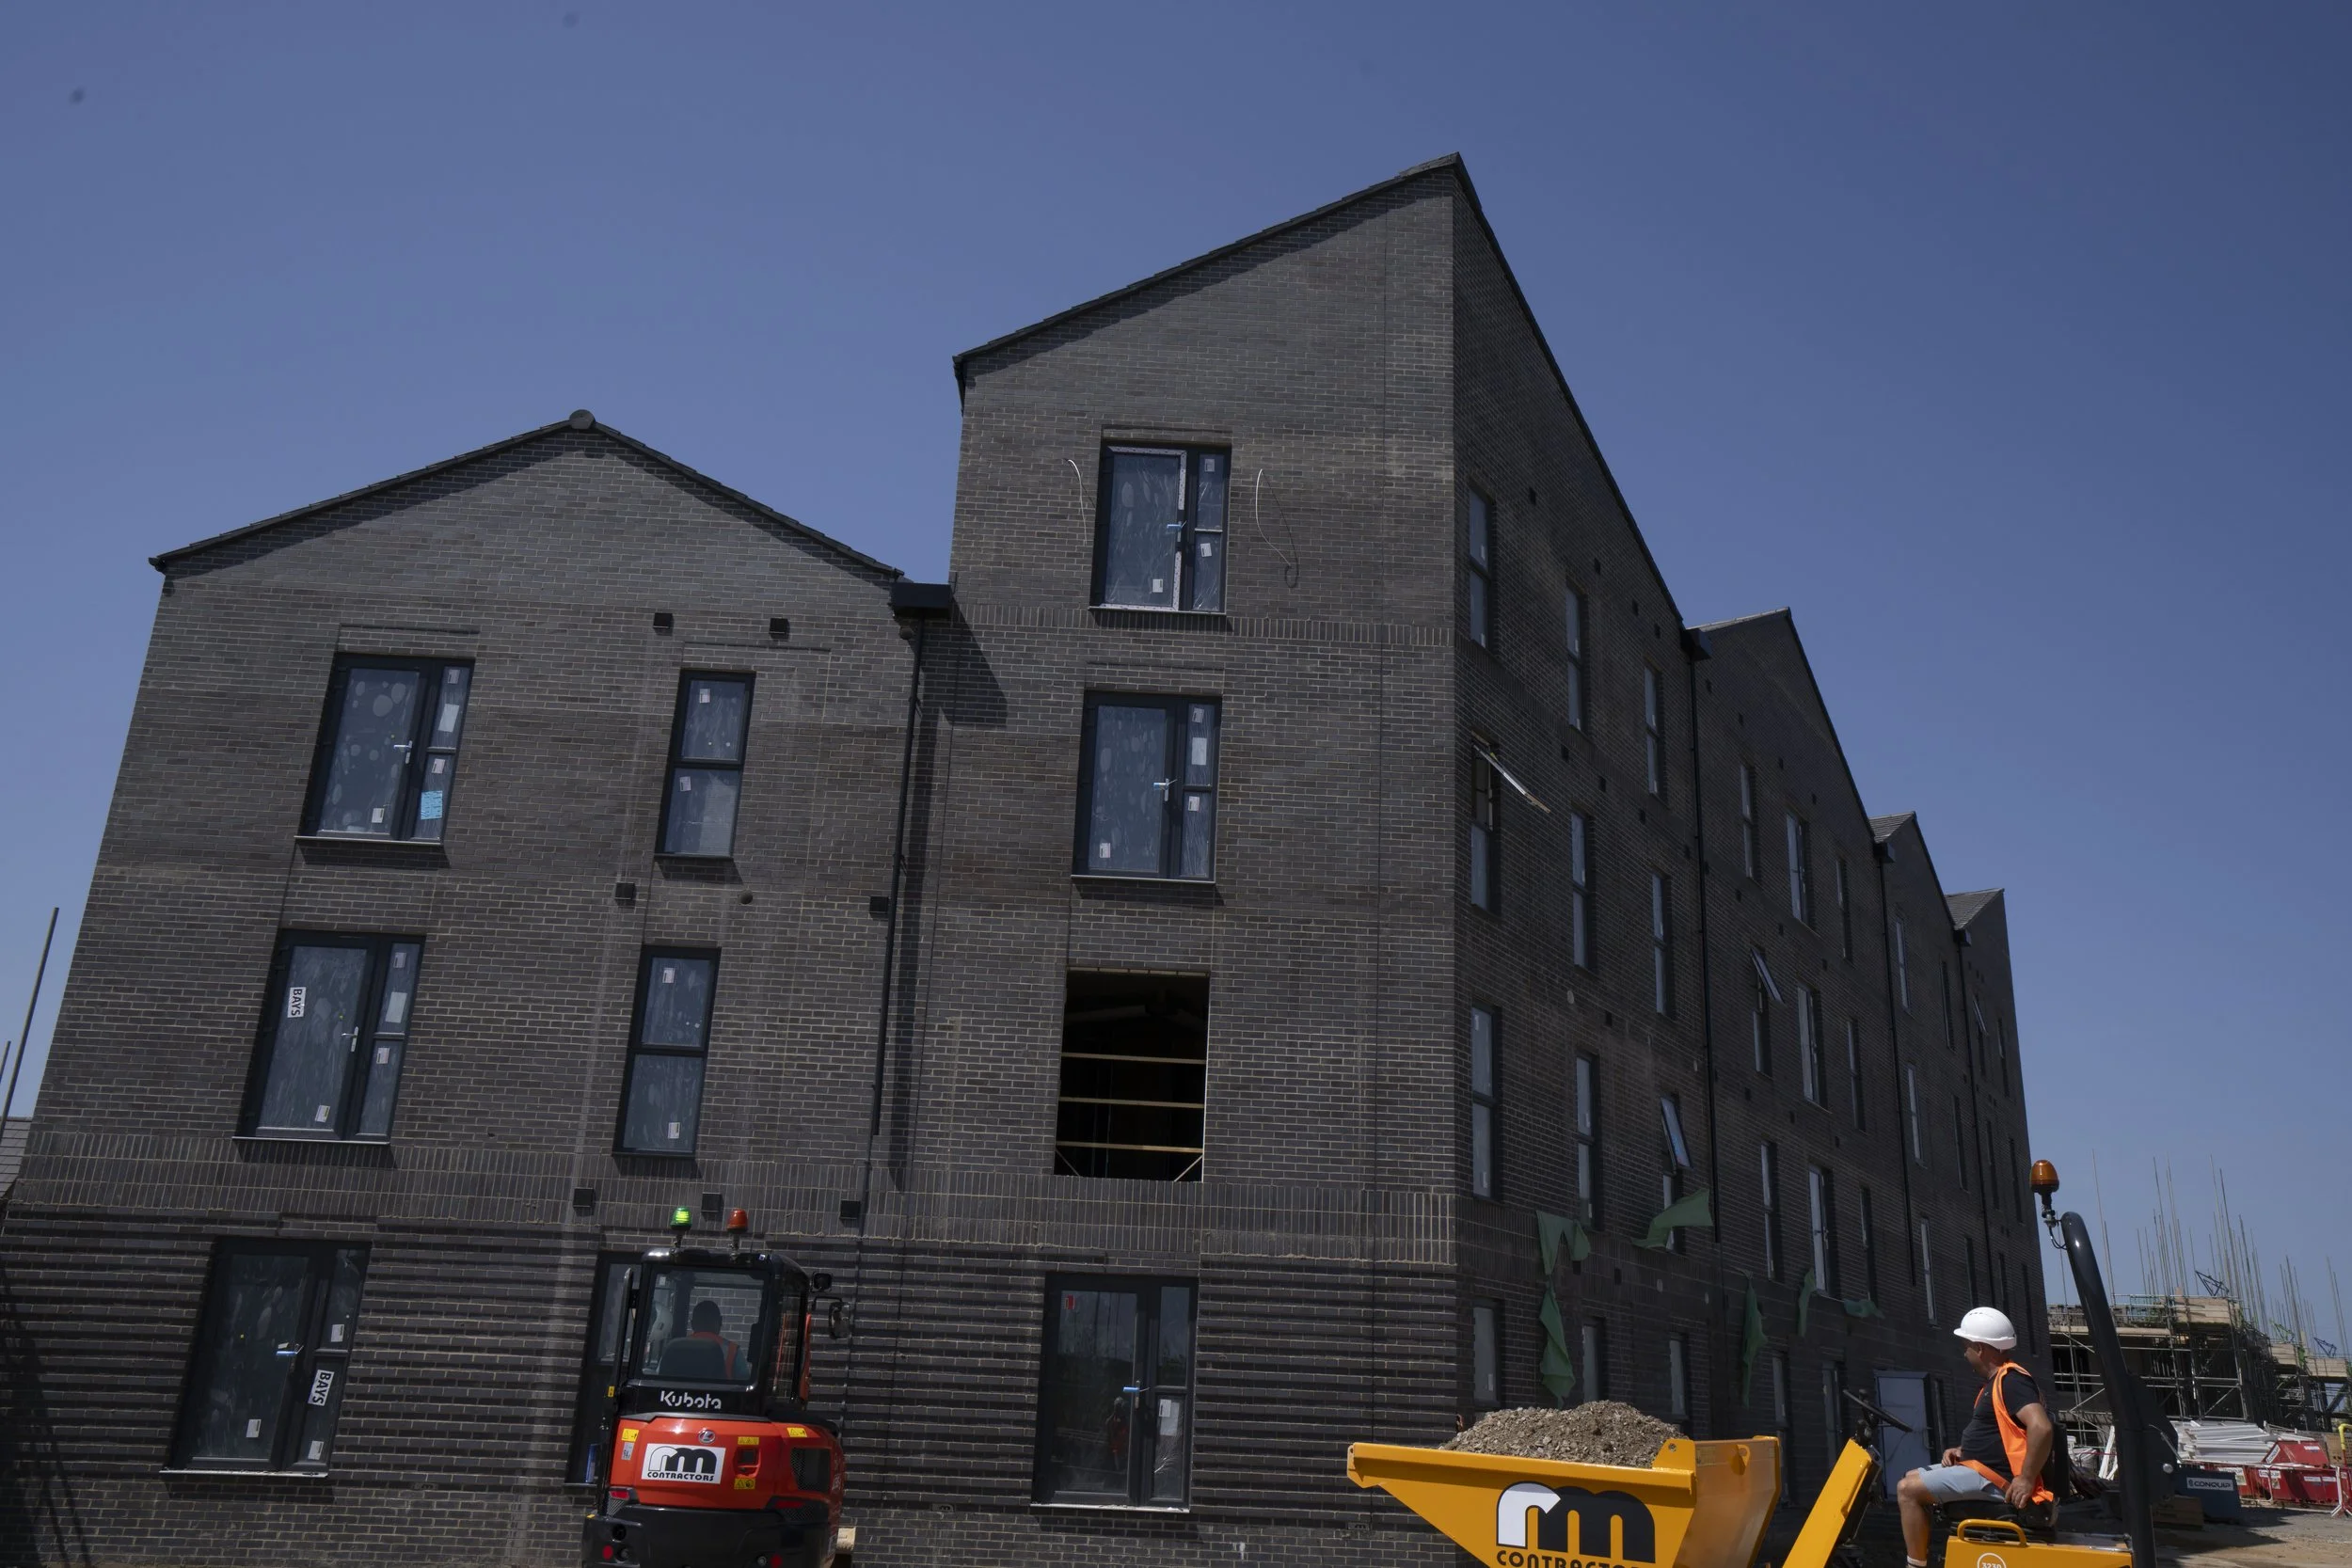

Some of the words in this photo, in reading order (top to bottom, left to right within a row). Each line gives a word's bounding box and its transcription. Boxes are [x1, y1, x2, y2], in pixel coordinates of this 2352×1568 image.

[291, 989, 303, 1016] BAYS
[312, 1372, 332, 1404] BAYS
[660, 1390, 722, 1410] Kubota
[648, 1446, 717, 1474] rm
[647, 1471, 715, 1482] CONTRACTORS
[1496, 1481, 1656, 1563] rm
